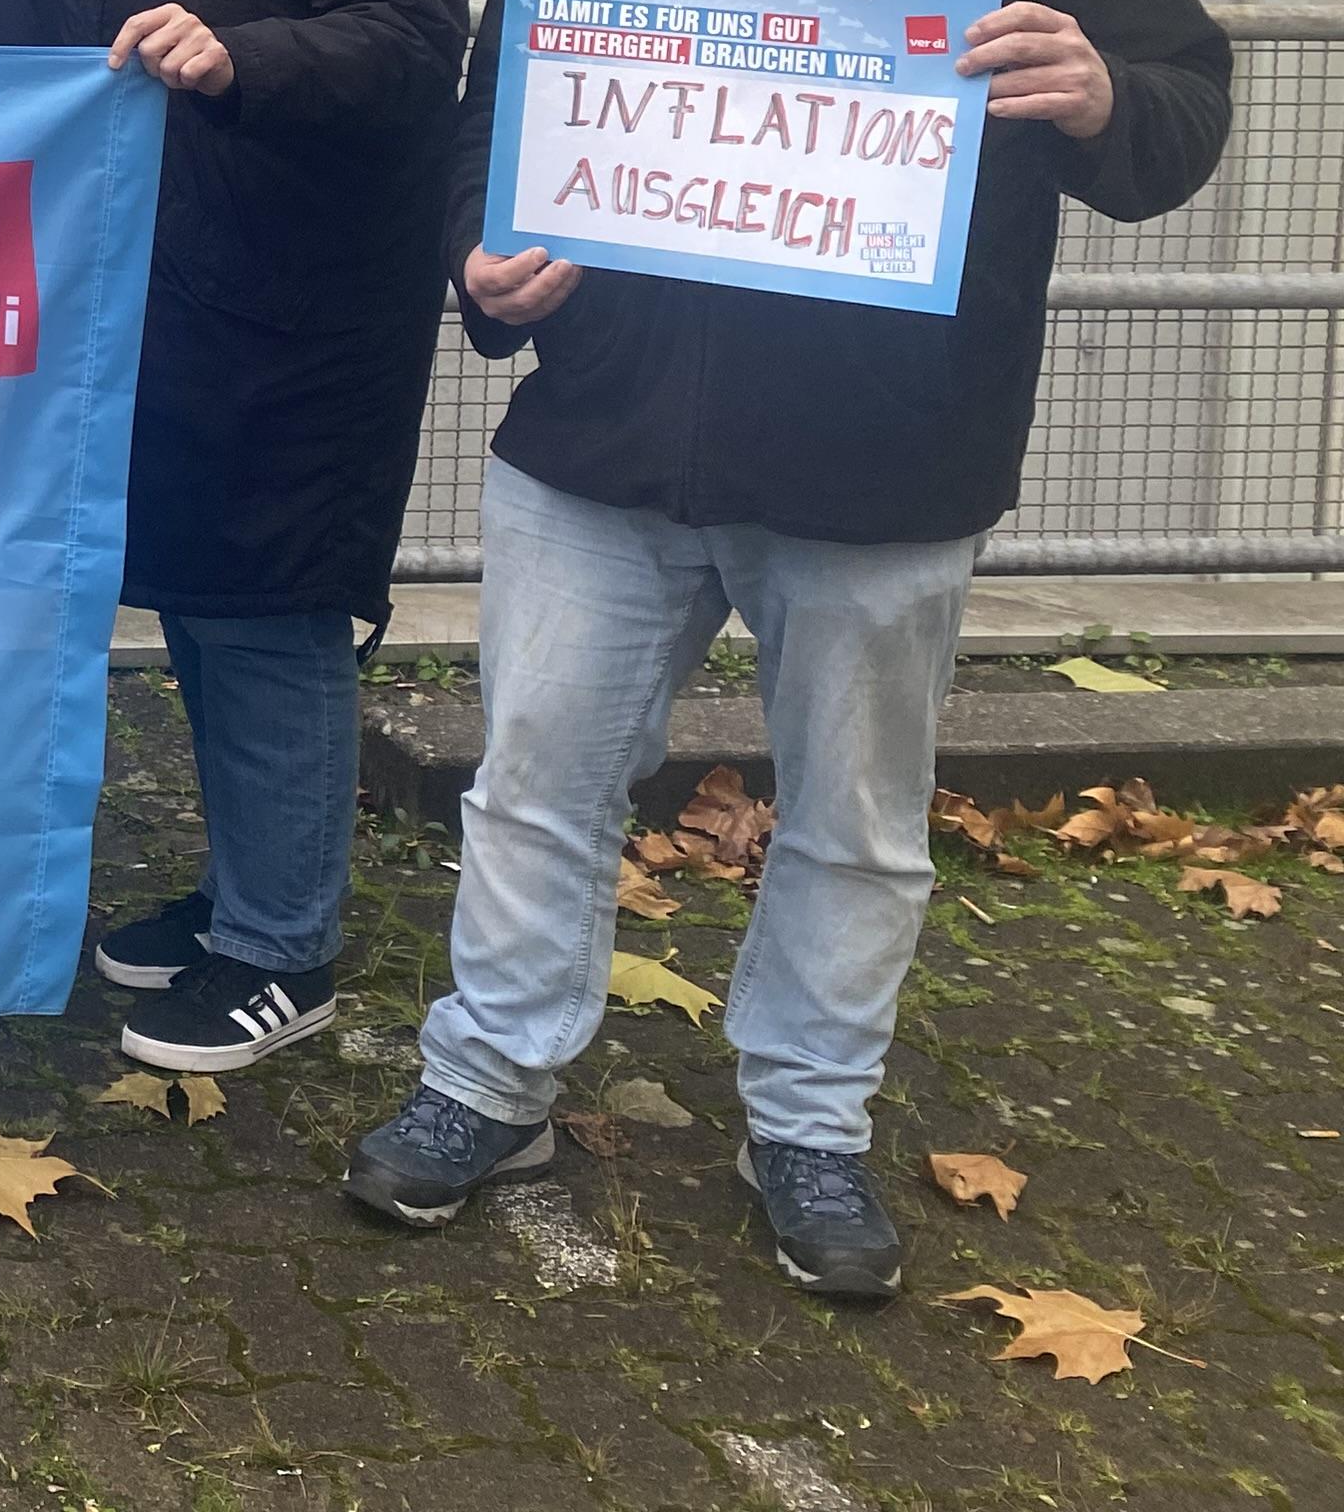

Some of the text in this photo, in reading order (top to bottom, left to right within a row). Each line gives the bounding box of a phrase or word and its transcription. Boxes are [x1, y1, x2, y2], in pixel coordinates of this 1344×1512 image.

[619, 4, 649, 28] ES
[656, 4, 700, 34] FÜR
[706, 11, 754, 38] UNS
[768, 17, 815, 43] GUT
[537, 27, 892, 81] WEITERGEHT, BRAUCHEN WIR:
[553, 157, 856, 258] AUSGLEICH
[860, 223, 906, 234] NUR MIT
[869, 235, 892, 247] UNS
[862, 248, 911, 260] BILDUNG
